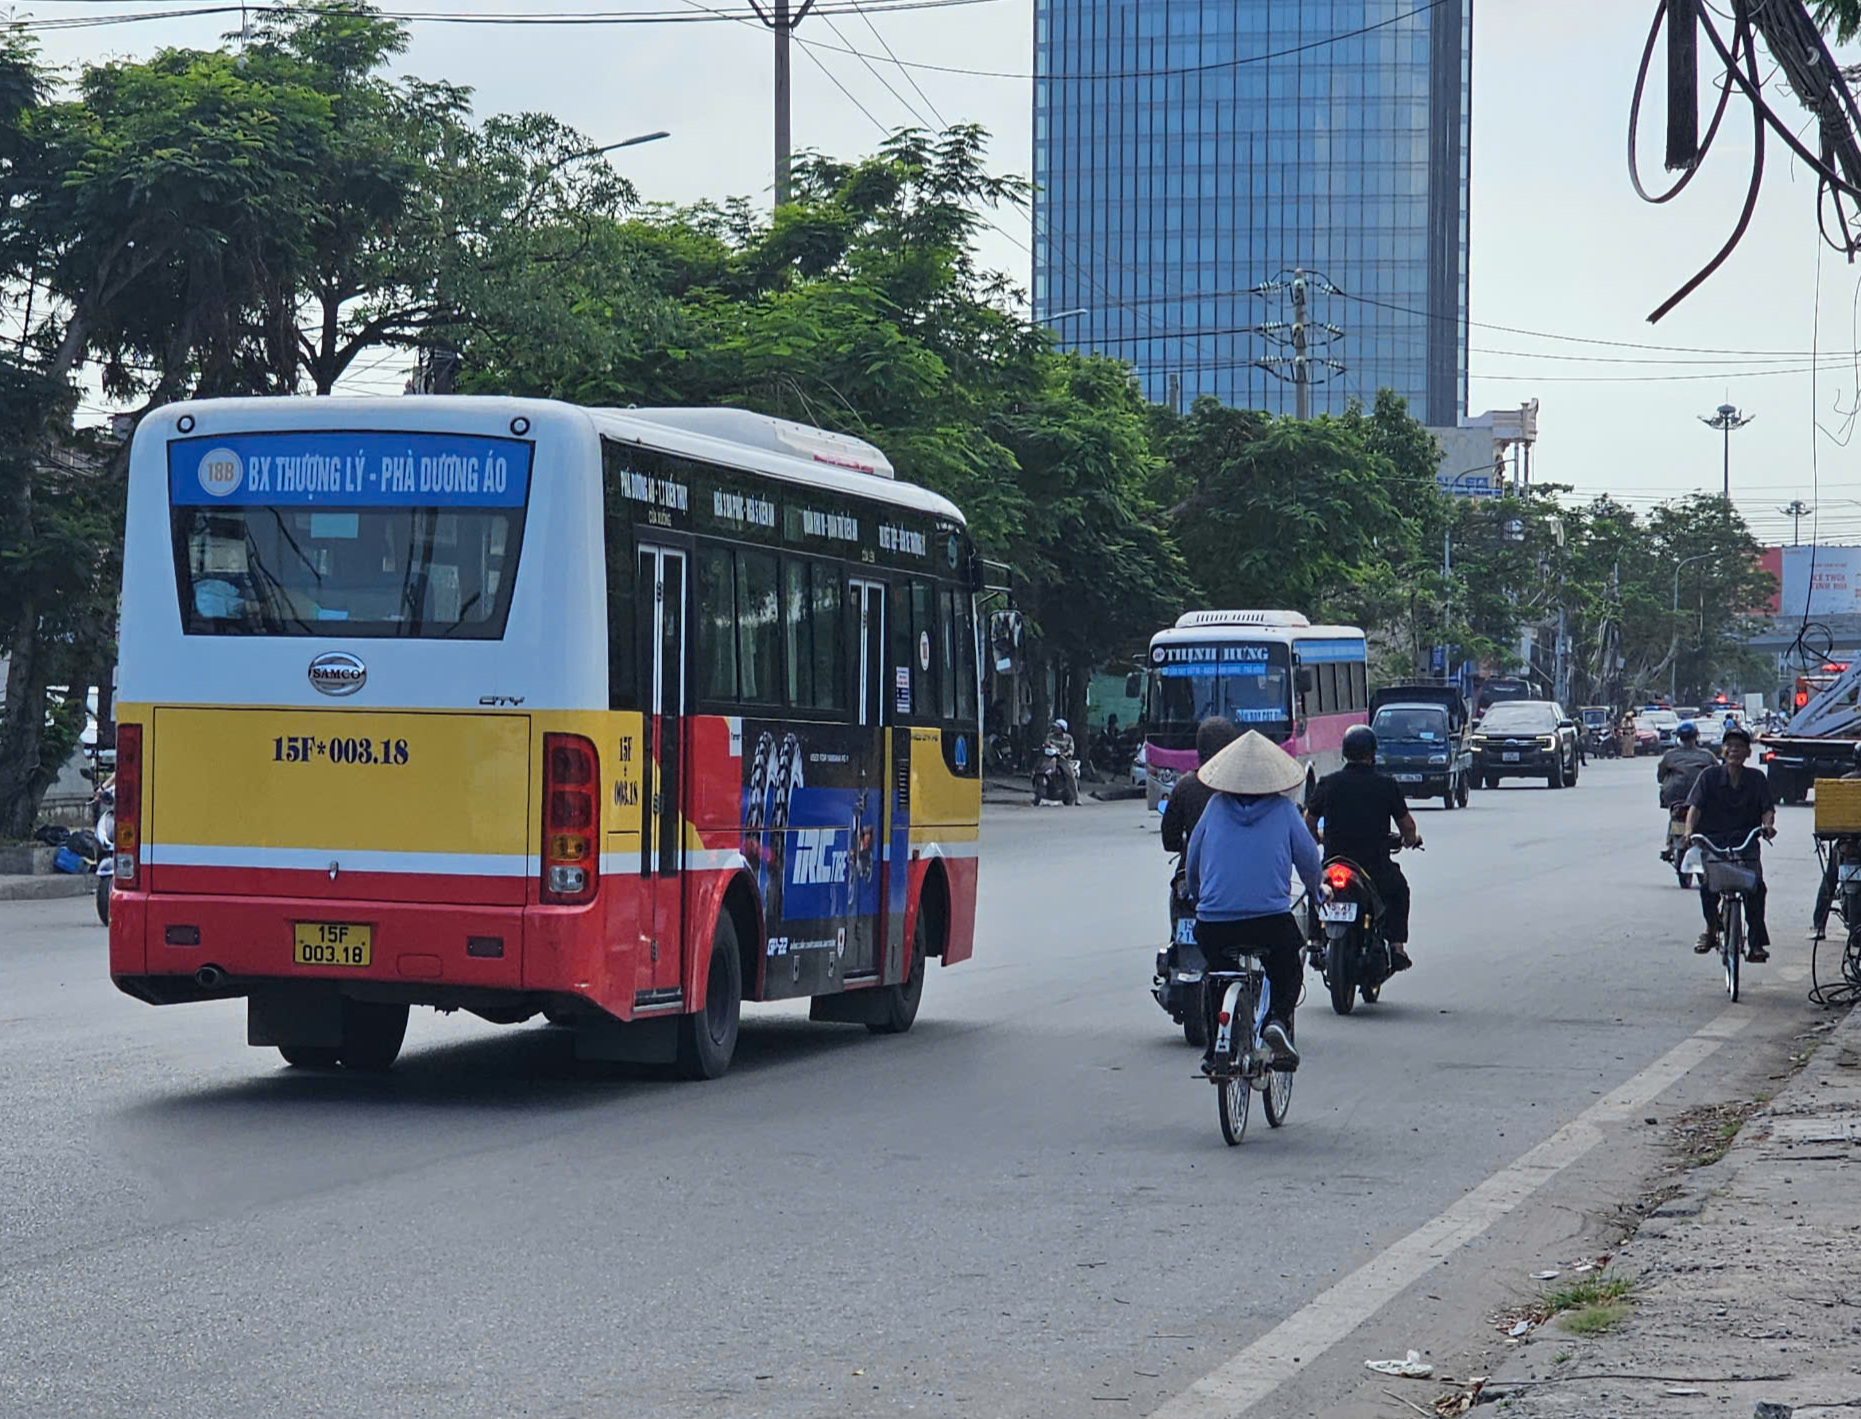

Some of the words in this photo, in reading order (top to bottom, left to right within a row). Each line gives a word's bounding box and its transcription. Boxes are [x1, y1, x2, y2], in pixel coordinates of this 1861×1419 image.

[207, 461, 235, 482] 18B
[248, 456, 271, 492] BX
[275, 452, 341, 501] THƯỢNG
[345, 449, 366, 492] LÝ
[381, 449, 415, 493] PHÀ
[420, 453, 479, 493] DƯƠNG
[483, 449, 508, 493] ÁO
[1166, 647, 1217, 663] THỊNH
[313, 668, 362, 680] SAMCO
[619, 736, 632, 762] 15F
[318, 925, 349, 944] 15F
[302, 944, 363, 963] 003.18
